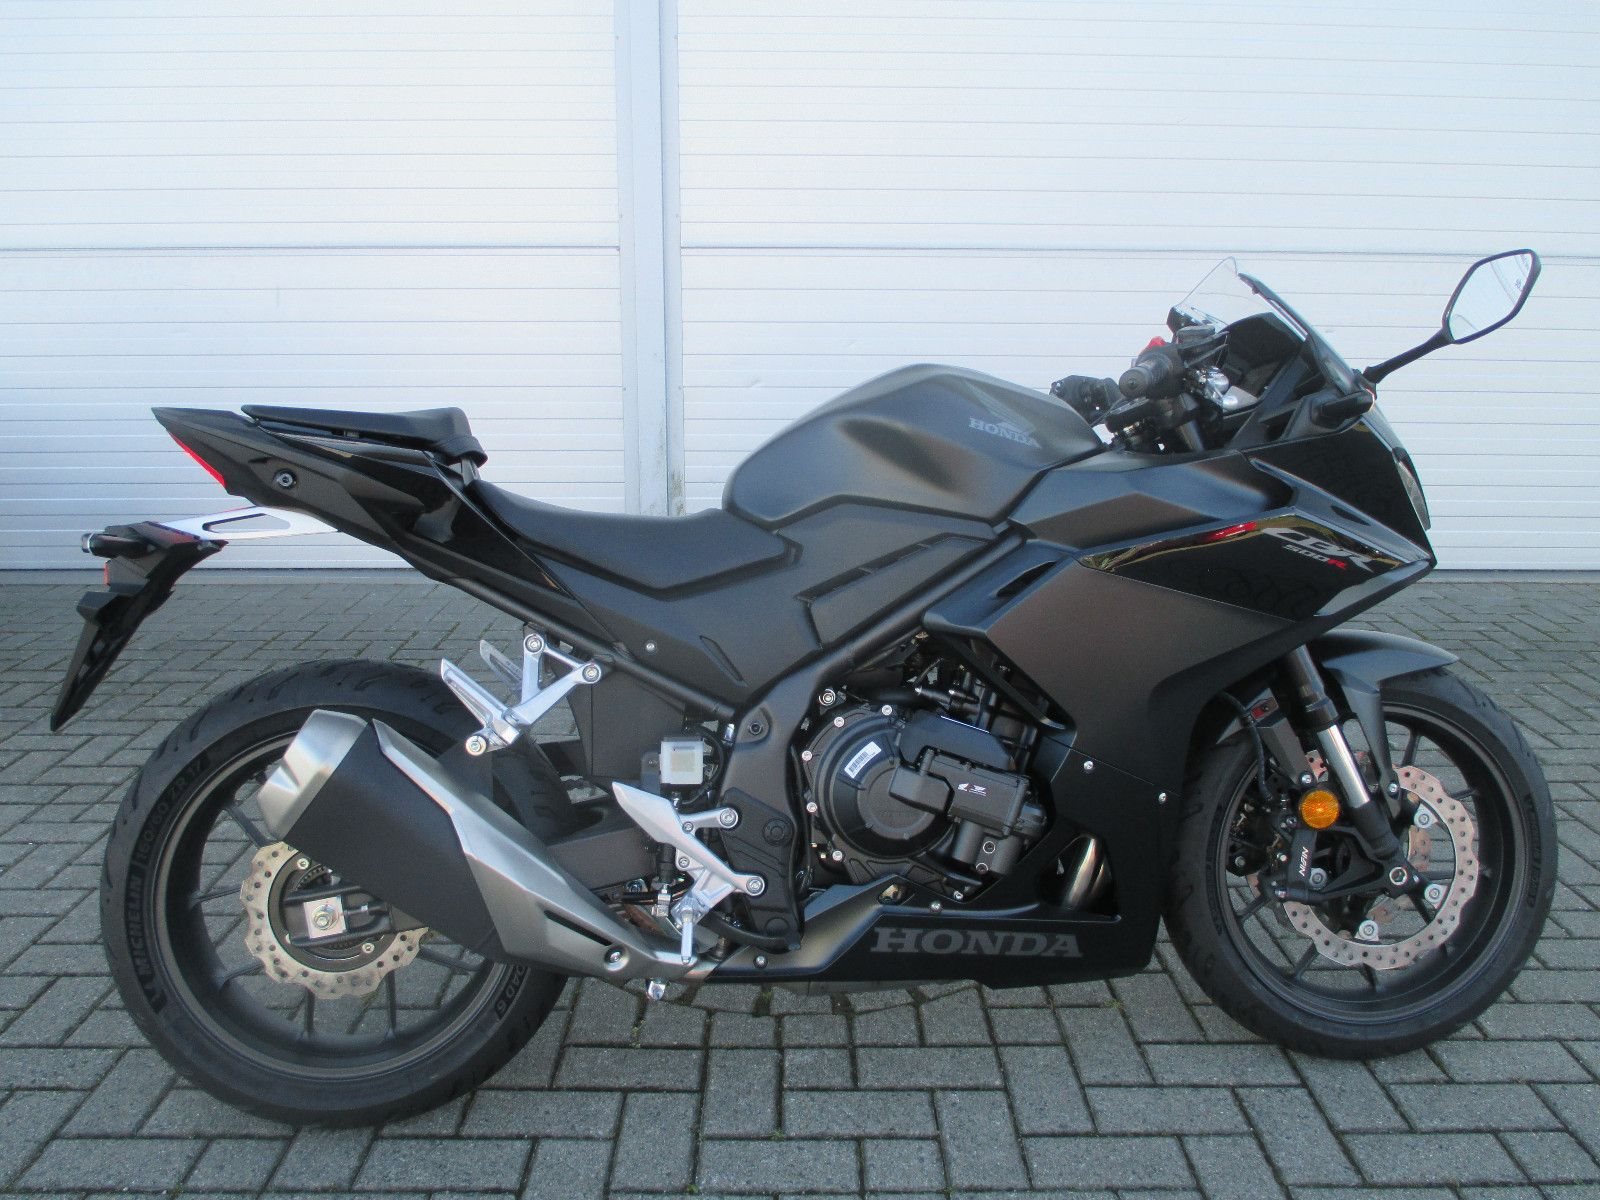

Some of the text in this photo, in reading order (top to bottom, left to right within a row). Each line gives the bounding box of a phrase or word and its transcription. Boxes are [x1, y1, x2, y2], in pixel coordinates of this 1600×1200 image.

[968, 416, 1041, 448] HONDA
[1262, 527, 1375, 574] CBR
[1282, 544, 1346, 570] 500R
[127, 875, 151, 976] MICHELIN
[870, 926, 1083, 958] HONDA
[504, 964, 527, 998] OAD
